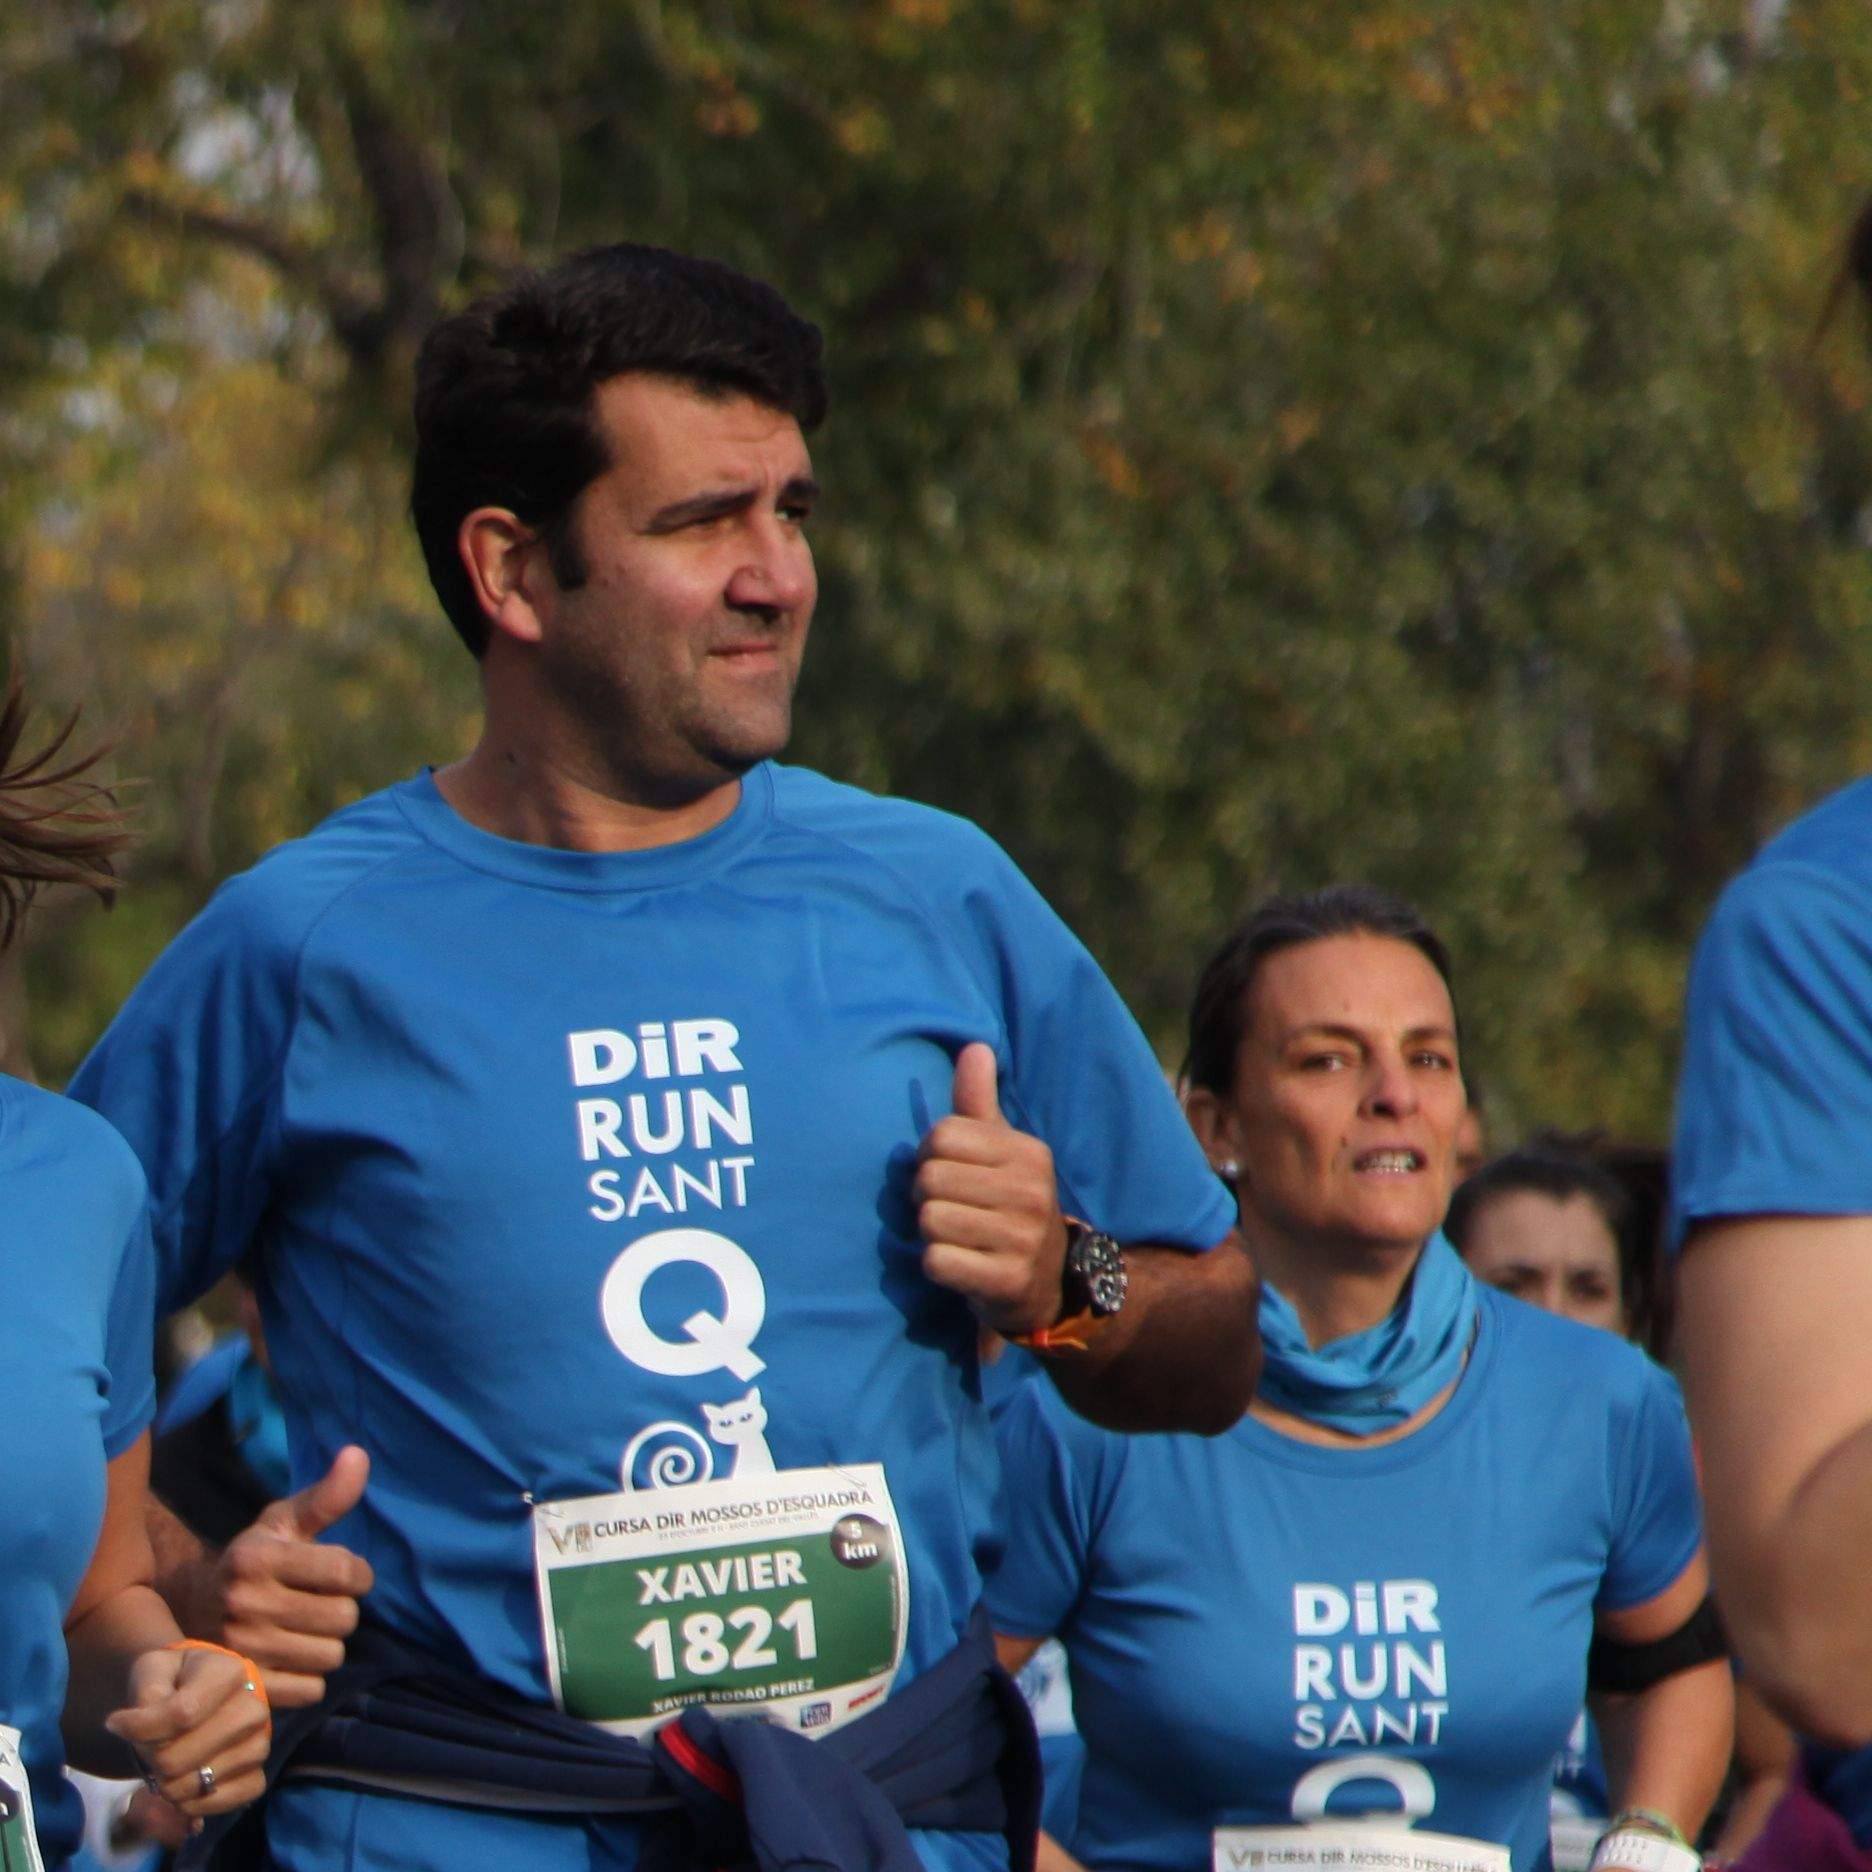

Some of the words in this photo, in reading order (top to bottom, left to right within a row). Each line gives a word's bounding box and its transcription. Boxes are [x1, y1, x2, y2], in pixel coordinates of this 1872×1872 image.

[568, 1017, 744, 1087] DiR
[578, 1084, 754, 1162] RUN
[589, 1156, 755, 1222] SANT
[601, 1227, 767, 1383] Q
[594, 1519, 652, 1539] CURSA
[690, 1503, 763, 1526] MOSSOS
[767, 1490, 873, 1516] D'ESQUADRA
[636, 1550, 808, 1606] XAVIER
[843, 1541, 878, 1560] km
[1293, 1578, 1441, 1636] DiR
[635, 1599, 818, 1680] 1821
[653, 1692, 706, 1713] XAVIER
[769, 1678, 815, 1698] PEREZ
[1295, 1640, 1447, 1700] RUN
[1293, 1701, 1449, 1750] SANT
